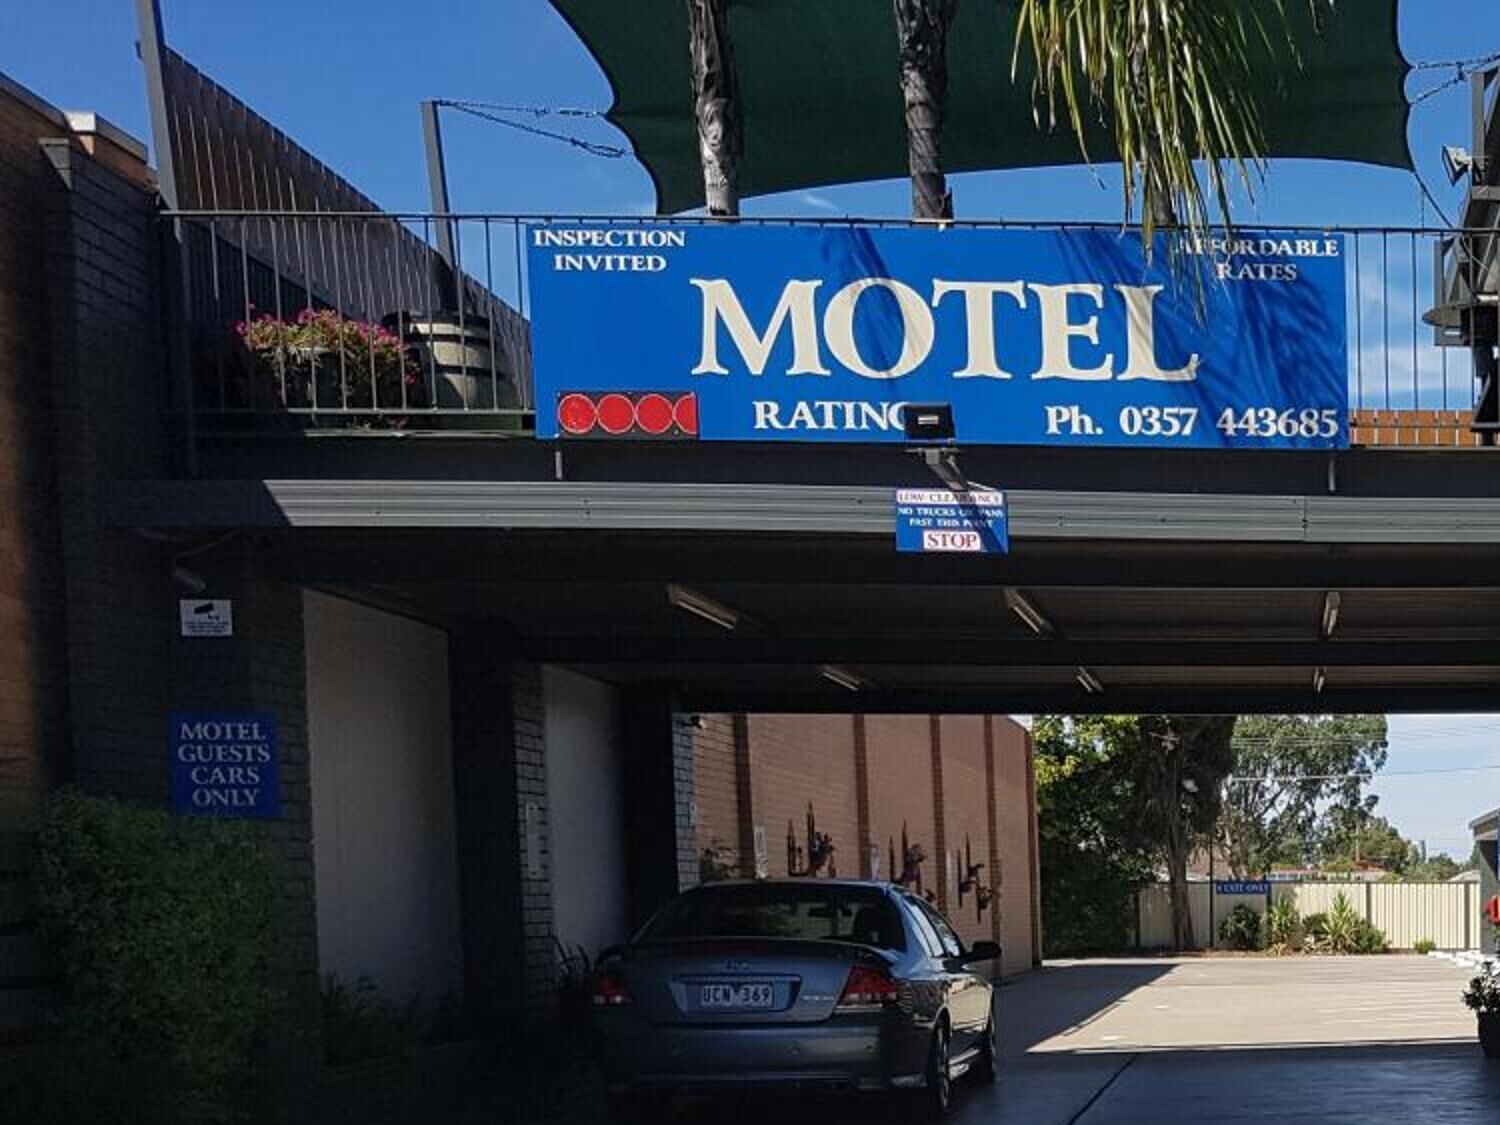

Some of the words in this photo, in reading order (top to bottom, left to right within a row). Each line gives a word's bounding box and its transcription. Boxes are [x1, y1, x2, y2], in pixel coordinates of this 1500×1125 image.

[533, 229, 686, 248] INSPECTION
[554, 253, 667, 272] INVITED
[1216, 263, 1297, 281] RATES
[689, 277, 1203, 382] MOTEL
[1046, 405, 1104, 436] Ph.
[1120, 406, 1199, 437] 0357
[1216, 408, 1339, 439] 443685
[927, 532, 978, 549] STOP
[180, 721, 267, 742] MOTEL
[177, 743, 271, 764] GUESTS
[191, 766, 261, 786] CARS
[191, 788, 259, 808] ONLY
